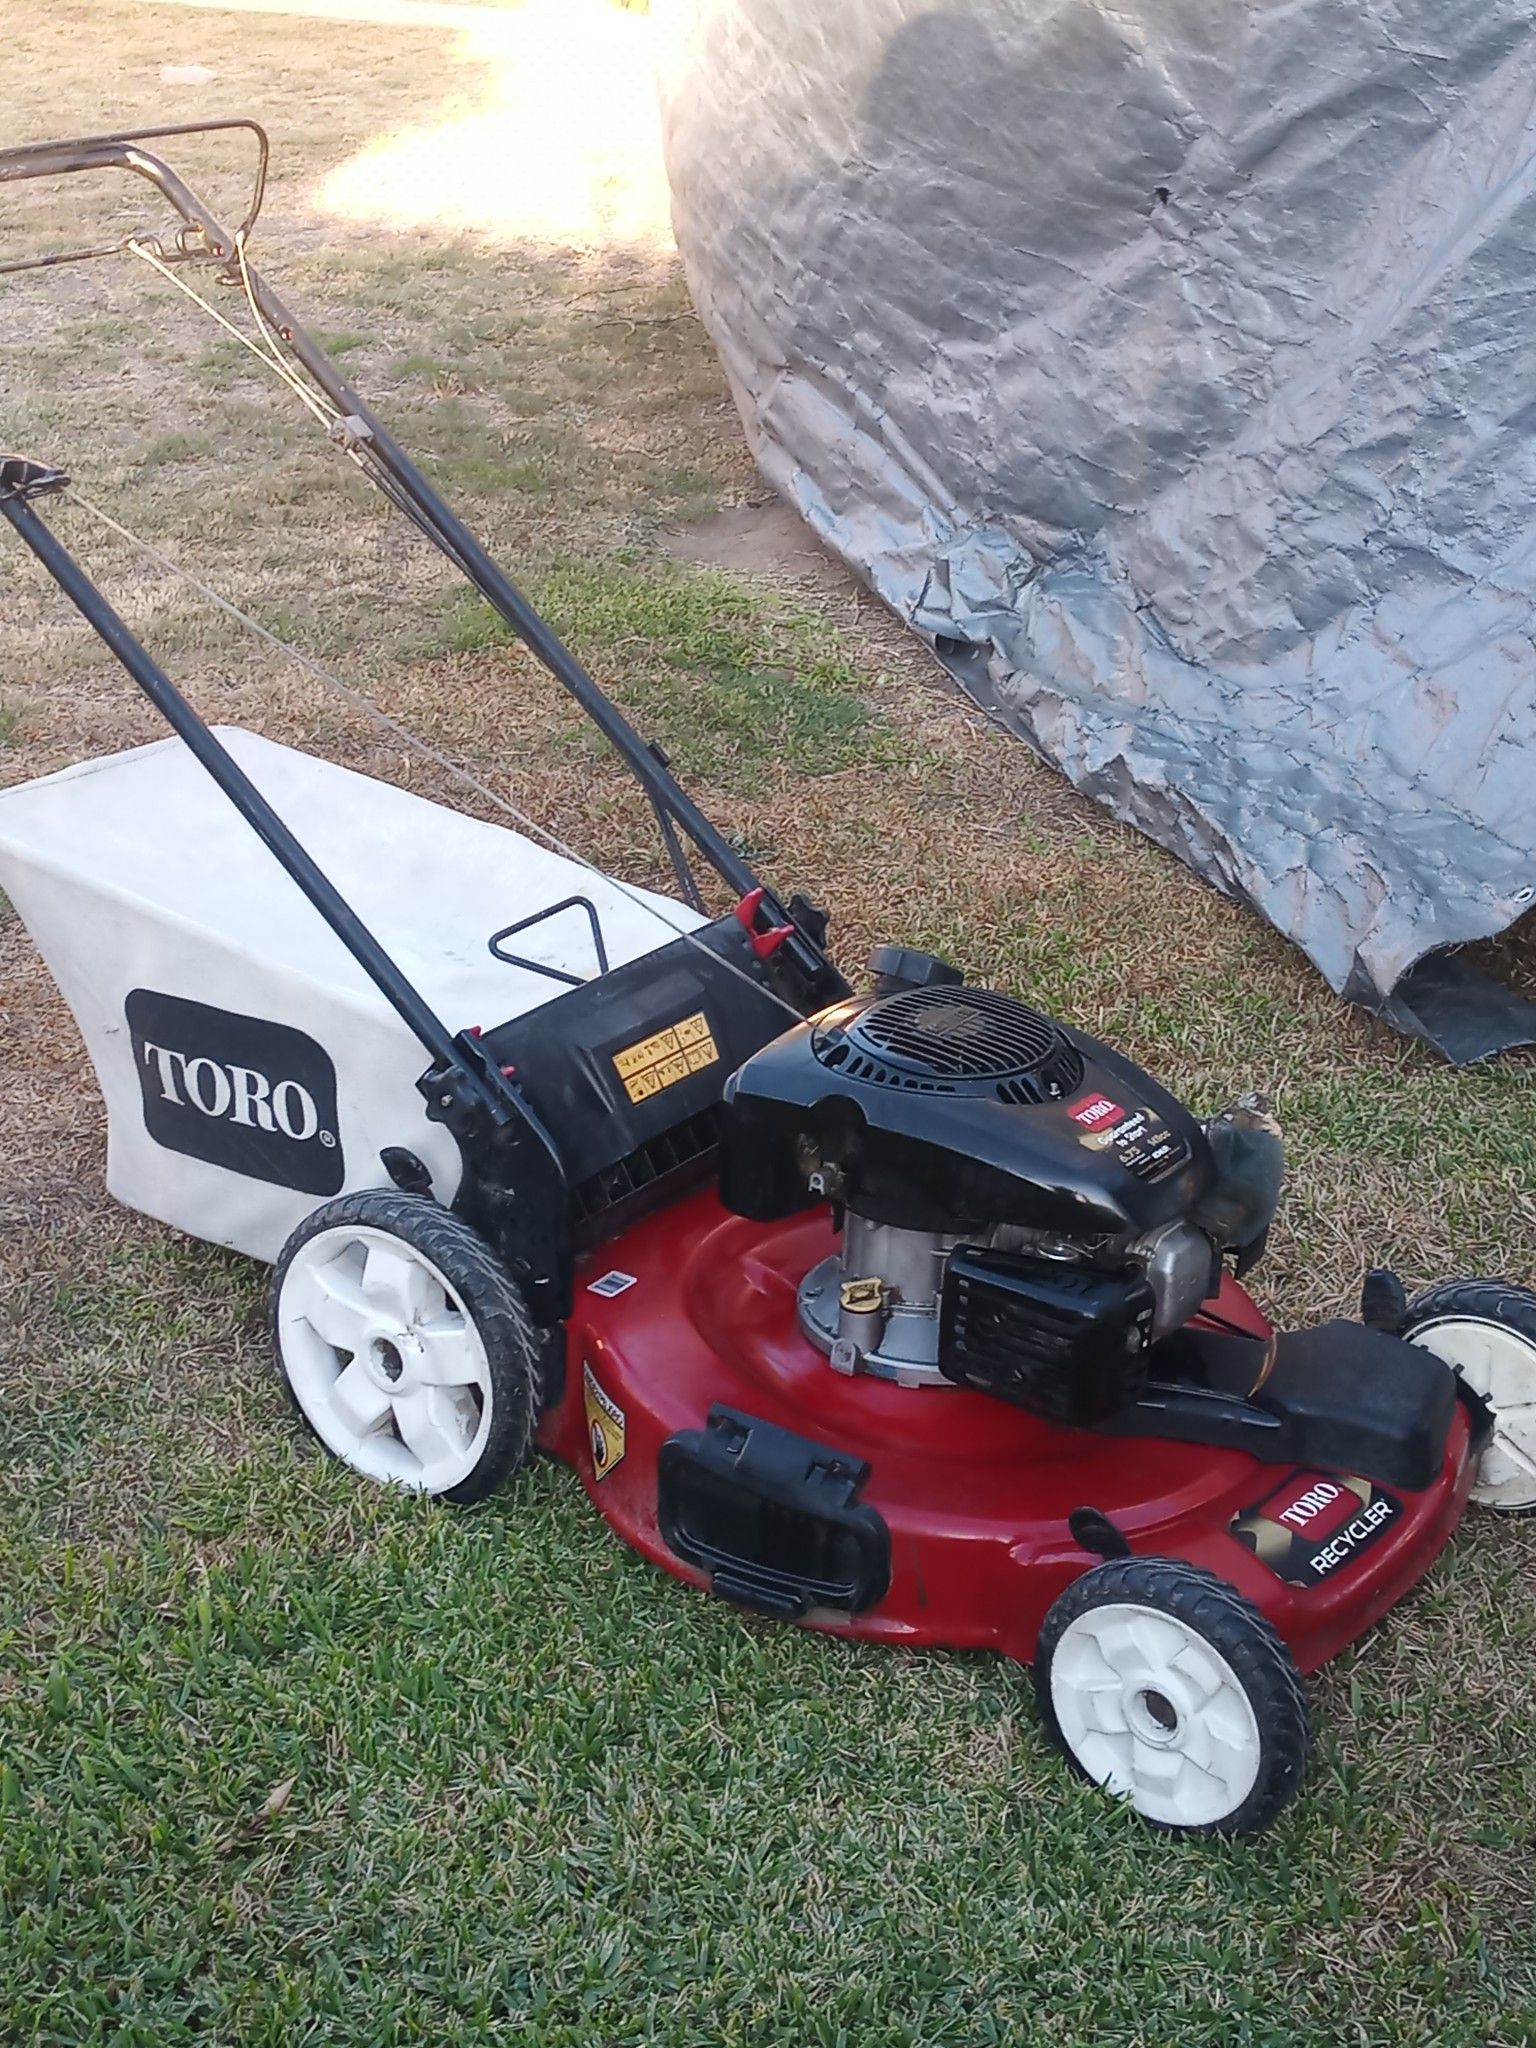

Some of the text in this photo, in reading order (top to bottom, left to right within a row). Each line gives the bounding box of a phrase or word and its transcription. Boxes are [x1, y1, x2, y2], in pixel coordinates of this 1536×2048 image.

[144, 1041, 318, 1141] TORO
[1075, 1099, 1116, 1125] TORO
[1097, 1112, 1145, 1145] Guaranteed
[1279, 1482, 1339, 1527] TORO
[1309, 1500, 1394, 1575] RECYCLER
